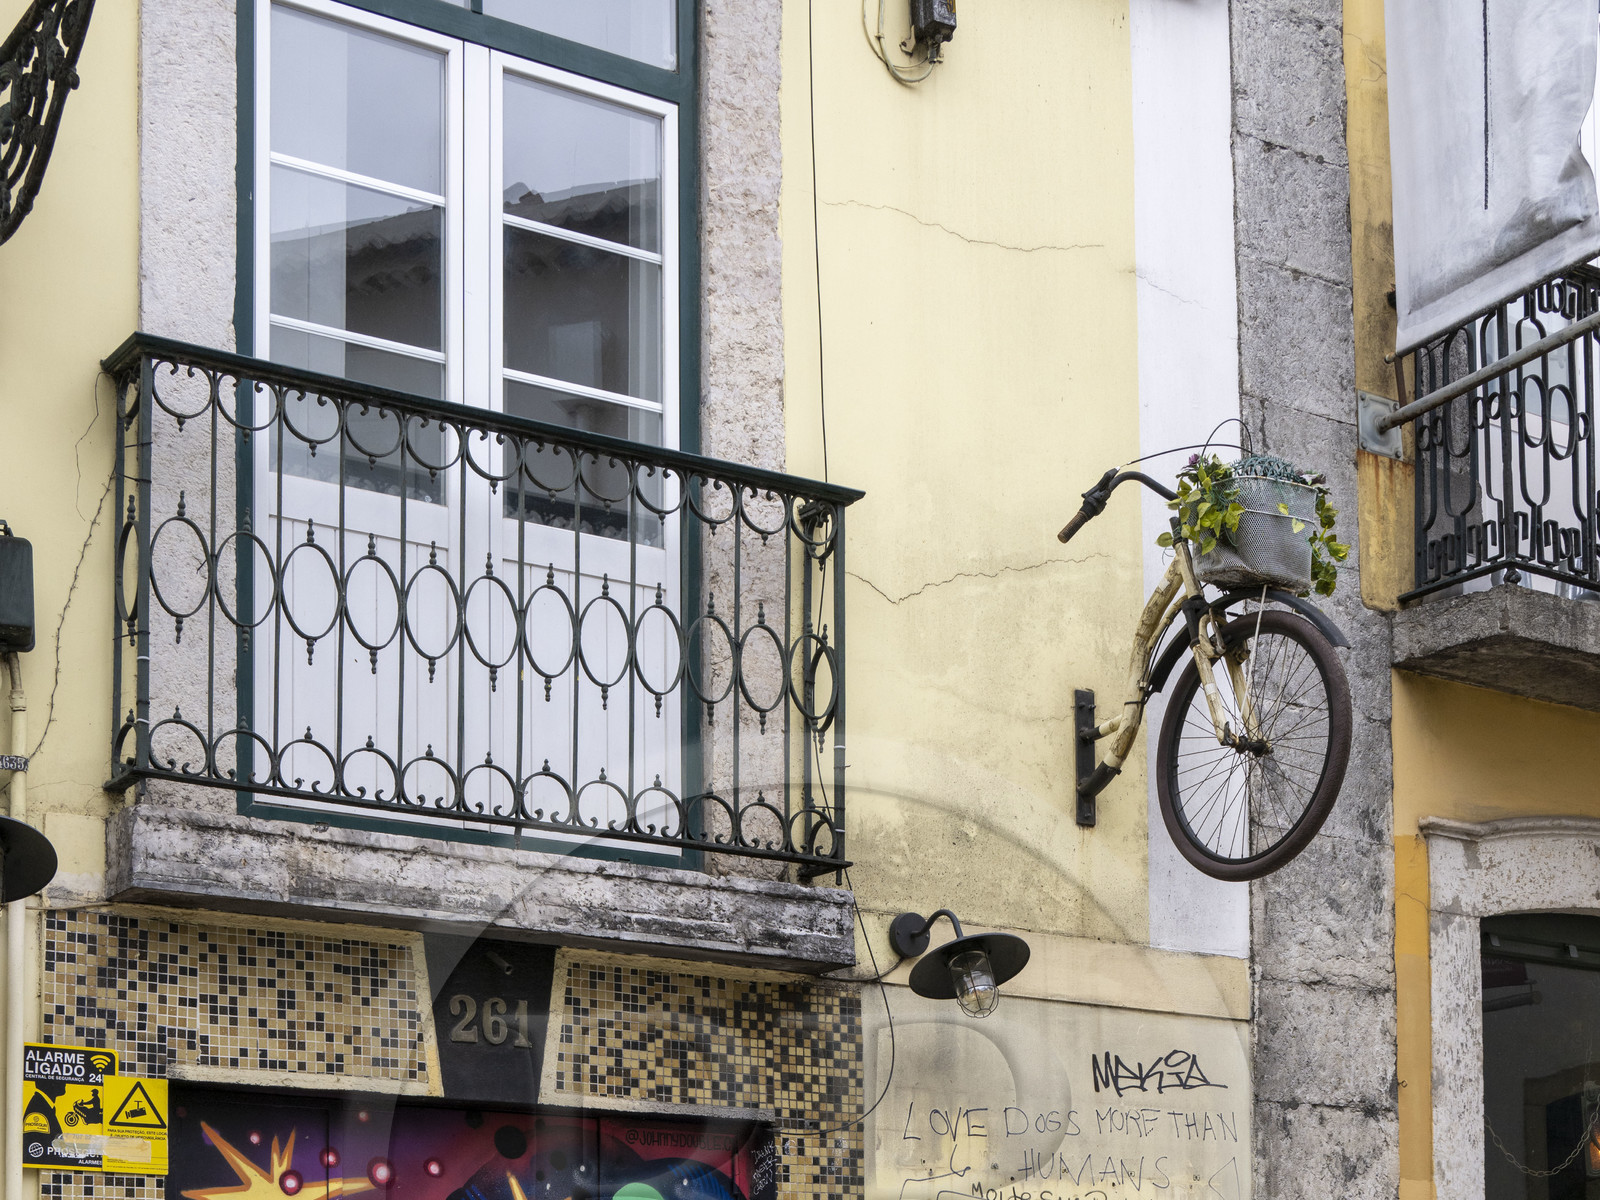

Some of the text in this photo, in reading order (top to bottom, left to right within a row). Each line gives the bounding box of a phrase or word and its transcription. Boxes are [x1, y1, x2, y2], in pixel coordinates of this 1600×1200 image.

[450, 994, 532, 1048] 261
[25, 1061, 85, 1077] LIGADO
[26, 1050, 85, 1064] ALARME
[902, 1102, 1239, 1143] LOVE DOGS MORE THAN
[1018, 1148, 1170, 1191] HUMANS
